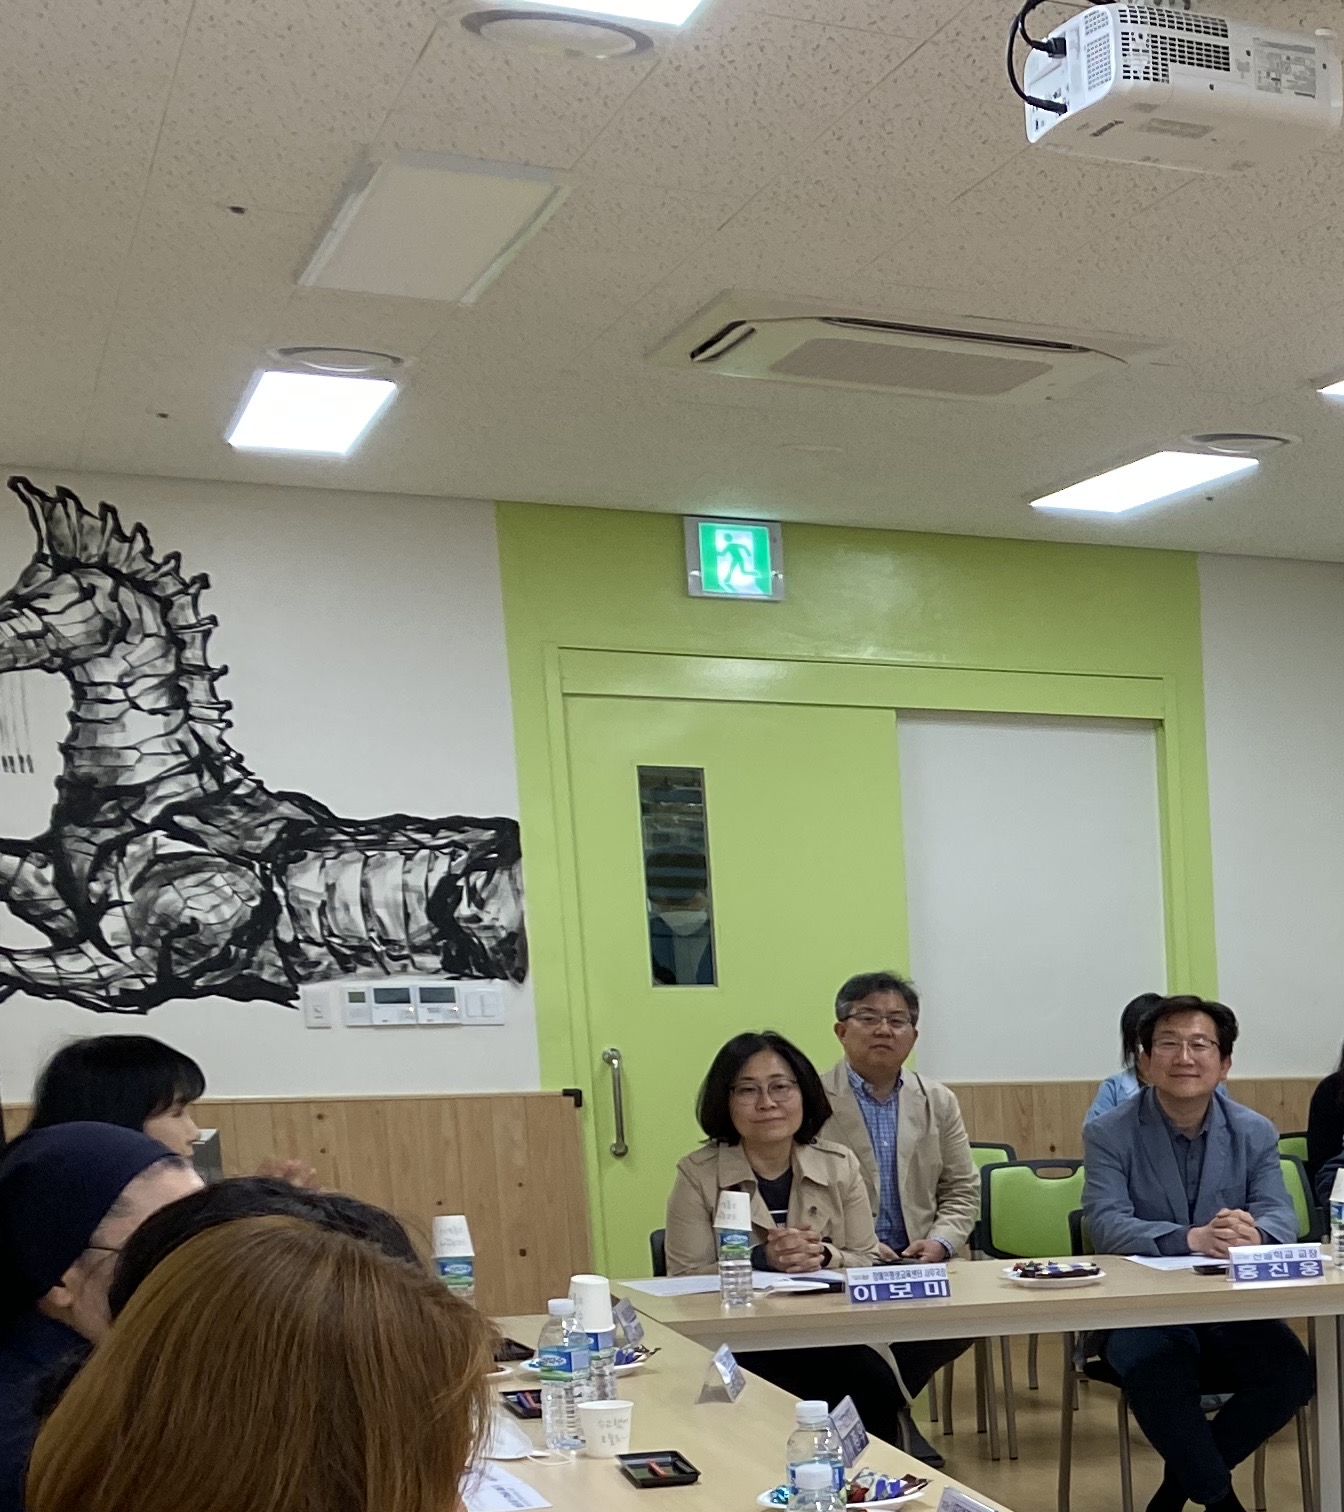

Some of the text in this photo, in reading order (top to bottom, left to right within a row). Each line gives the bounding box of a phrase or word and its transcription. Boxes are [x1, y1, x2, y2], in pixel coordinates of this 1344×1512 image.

[1297, 1248, 1318, 1259] 교장
[1237, 1260, 1320, 1280] 홍진웅
[853, 1280, 949, 1302] 이보미
